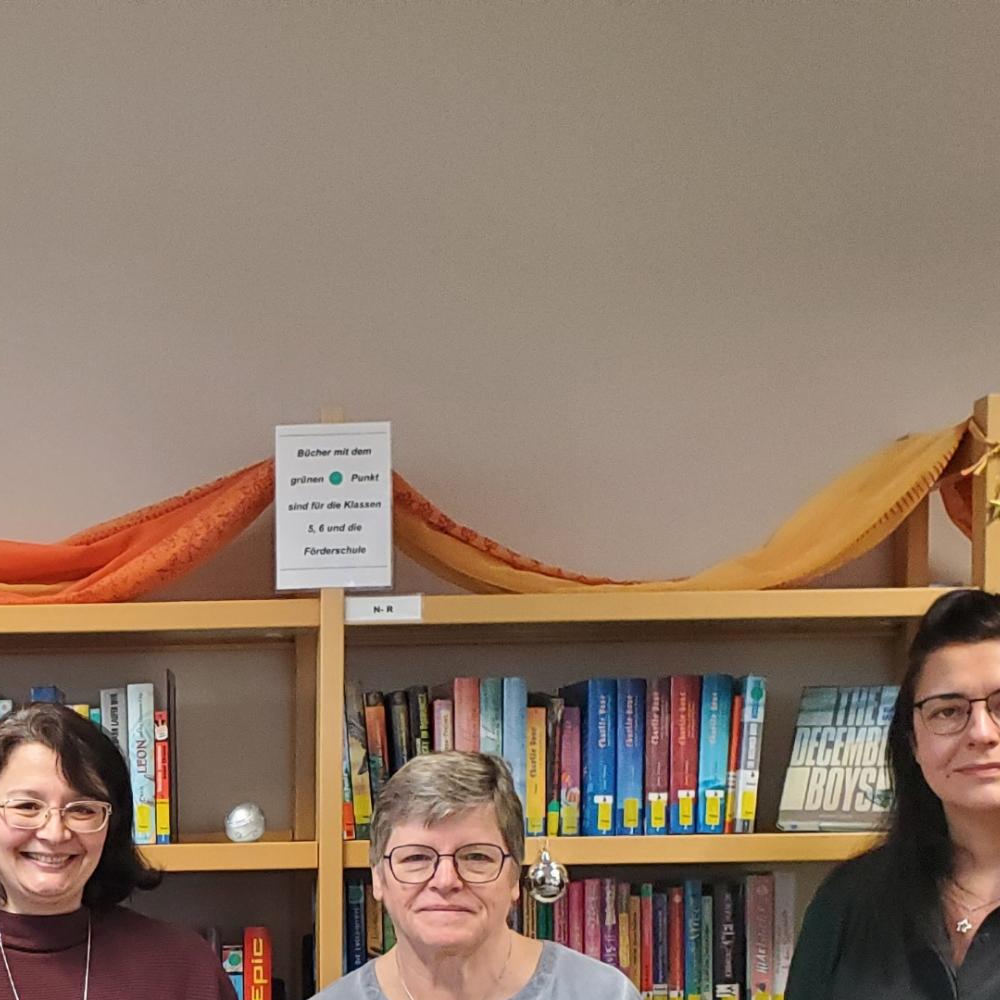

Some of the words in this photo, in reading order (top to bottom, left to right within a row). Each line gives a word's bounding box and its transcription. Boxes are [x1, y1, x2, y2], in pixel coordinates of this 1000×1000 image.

[297, 448, 332, 458] Bücher
[333, 447, 349, 456] mit
[351, 446, 372, 456] dem
[290, 475, 324, 487] grünen
[351, 472, 380, 483] Punkt
[288, 502, 309, 511] sind
[311, 501, 325, 510] für
[326, 501, 341, 510] die
[343, 500, 382, 509] Klassen
[307, 524, 316, 534] 5,
[318, 523, 325, 533] 6
[327, 523, 346, 533] und
[347, 522, 362, 532] die
[303, 545, 367, 556] Förderschule
[835, 686, 882, 726] THE
[790, 727, 890, 767] DECEMB
[136, 740, 148, 774] LEON
[804, 767, 876, 812] BOYS
